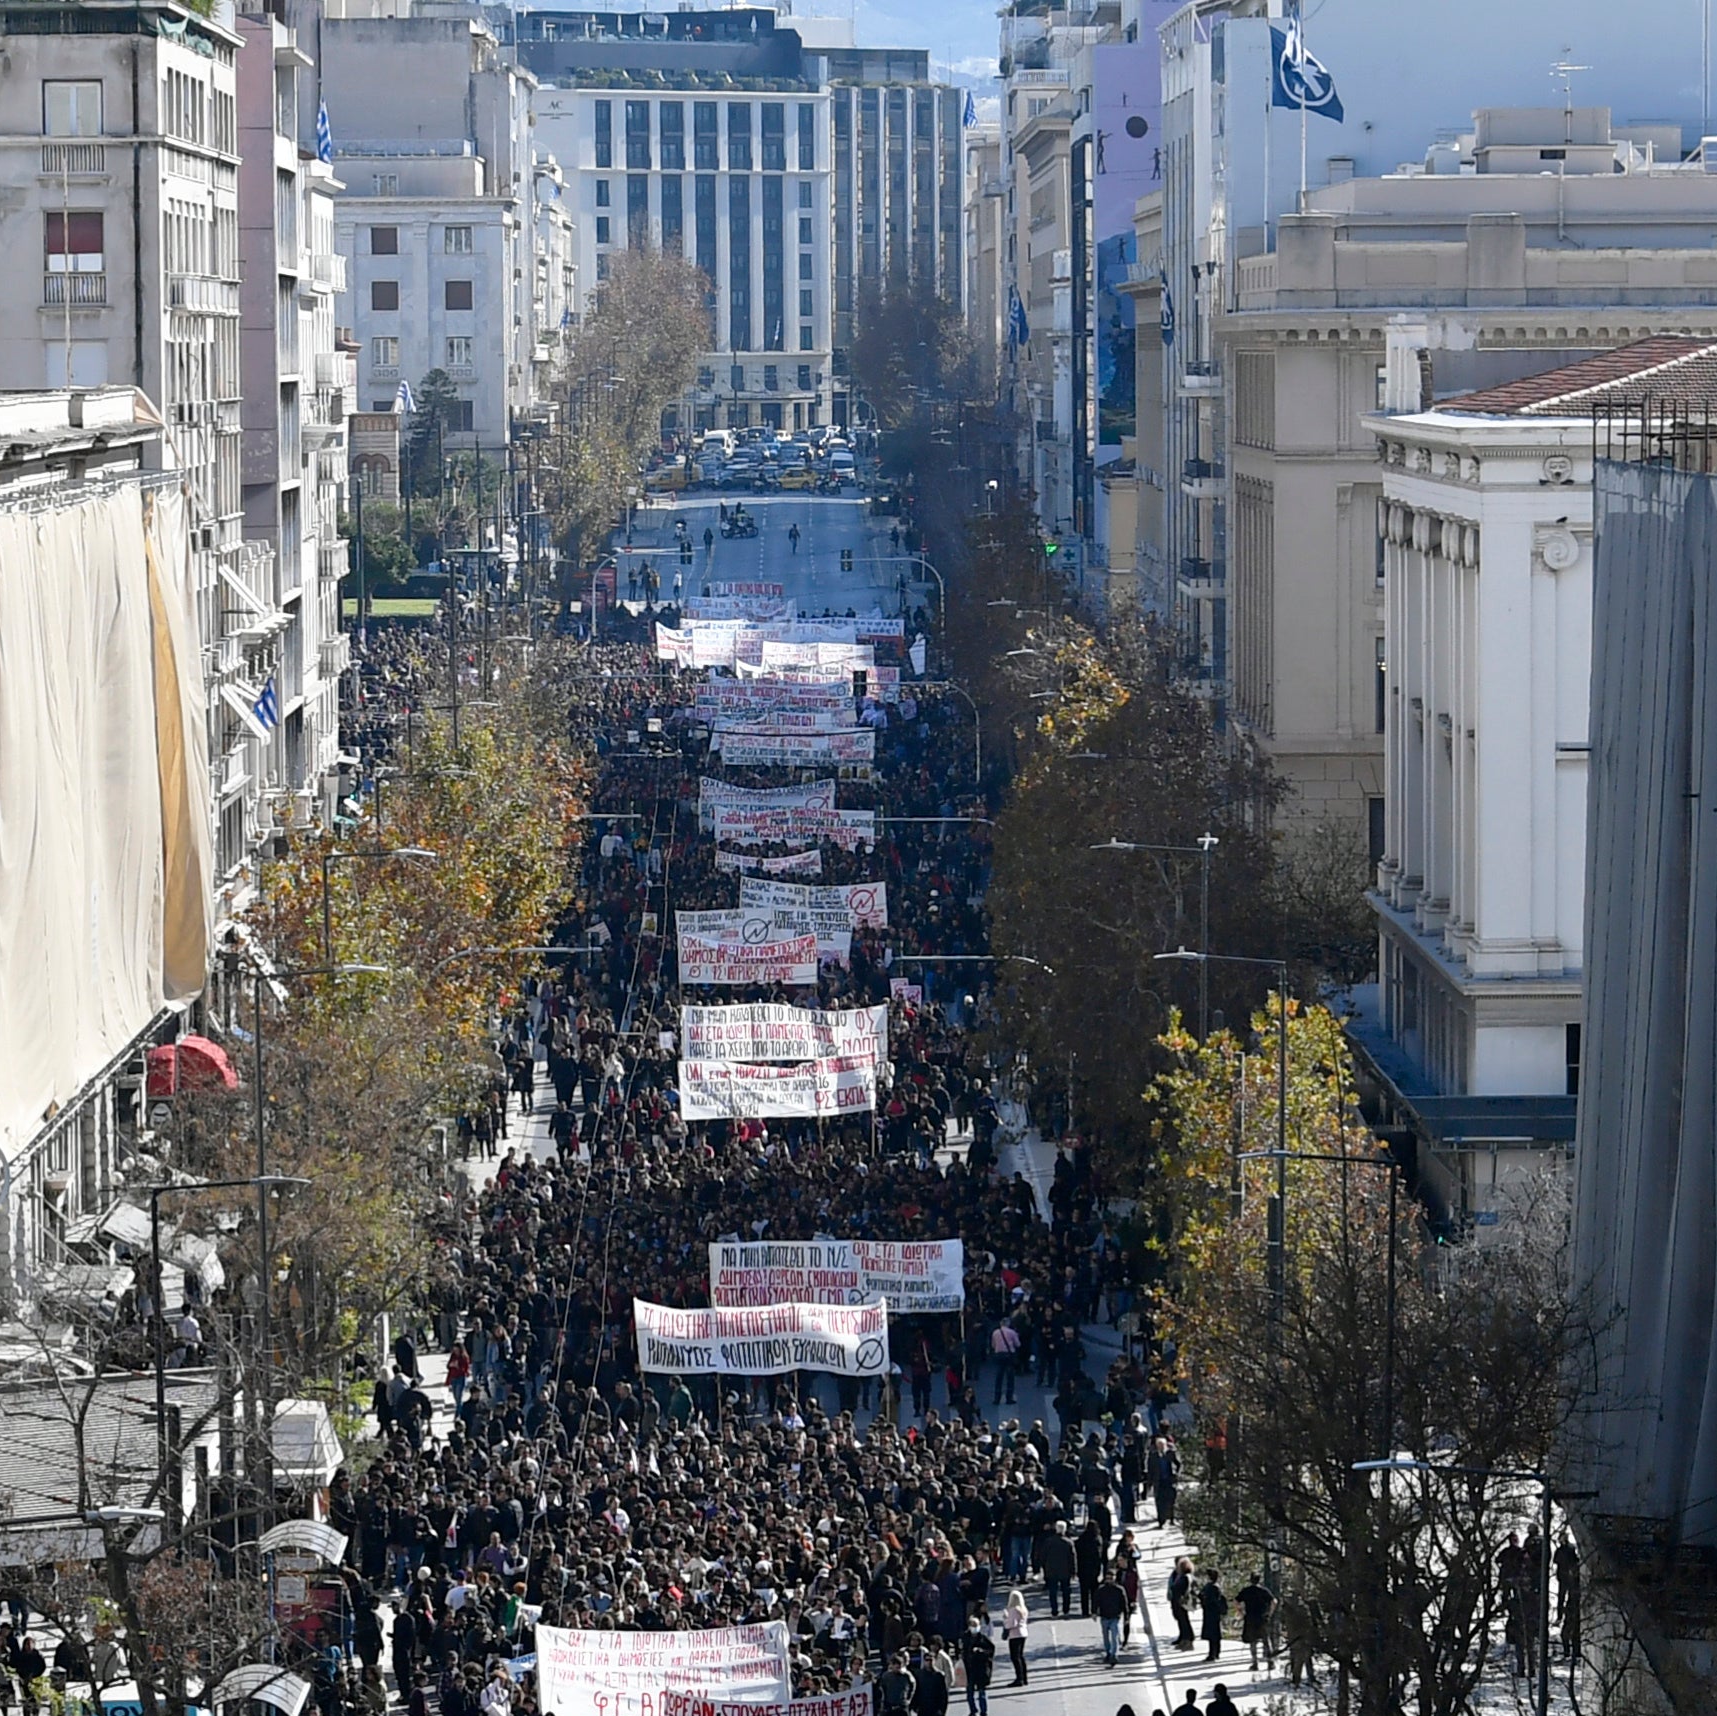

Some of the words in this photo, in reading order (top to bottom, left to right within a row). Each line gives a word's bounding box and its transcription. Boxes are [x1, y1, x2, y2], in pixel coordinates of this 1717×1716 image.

[818, 1076, 829, 1089] 16
[599, 1632, 622, 1650] ΣΤΑ
[688, 1625, 765, 1650] ΠΑΝΕΠΙΣΤΗΜΙΑ
